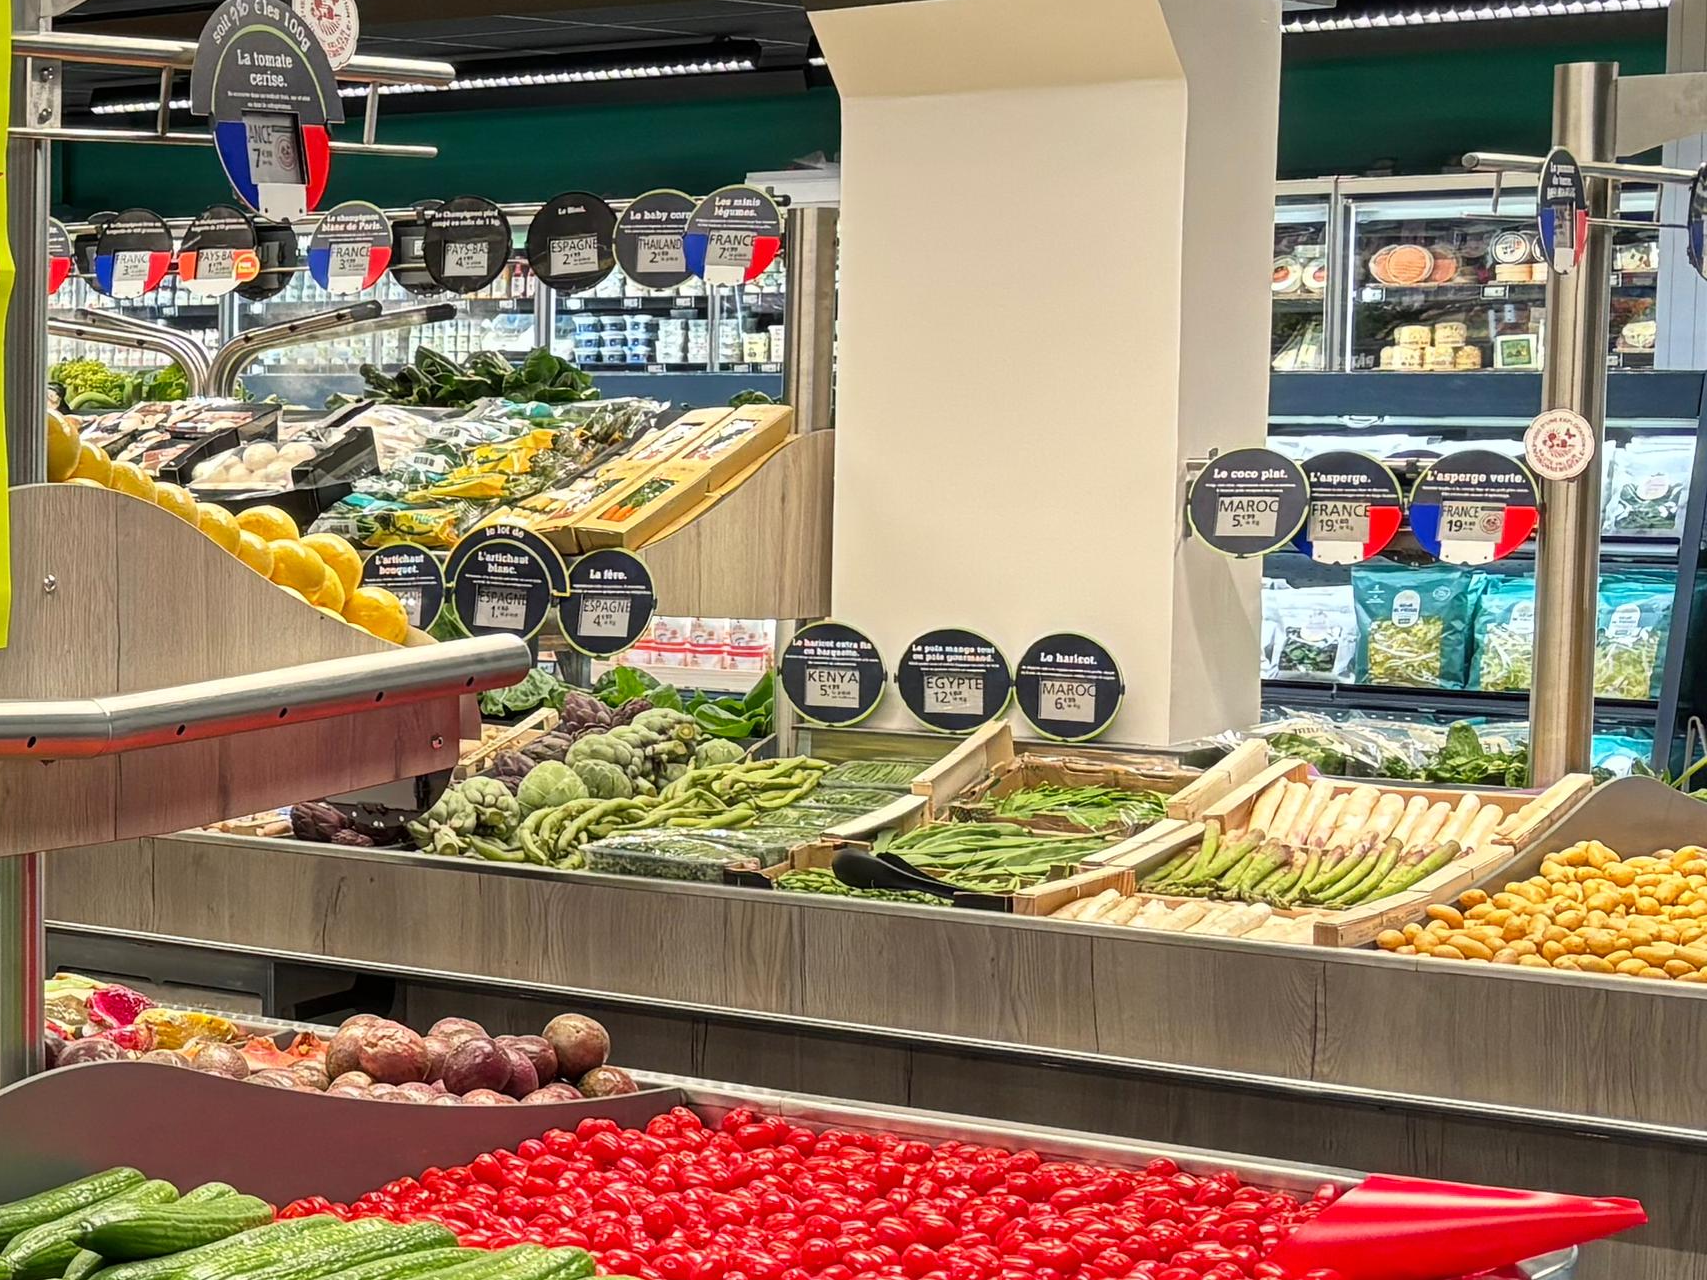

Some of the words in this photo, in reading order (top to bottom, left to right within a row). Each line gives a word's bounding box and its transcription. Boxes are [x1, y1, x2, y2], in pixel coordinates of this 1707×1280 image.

[262, 0, 280, 20] les
[284, 12, 311, 53] 100g
[237, 49, 251, 66] La
[254, 51, 293, 69] tomate
[250, 71, 288, 87] cerise.
[248, 124, 273, 145] ANCE
[715, 197, 730, 206] Les
[734, 197, 761, 206] minis
[630, 211, 641, 220] Le
[643, 210, 667, 223] baby
[714, 206, 757, 217] légumes.
[327, 214, 336, 222] Le
[337, 213, 379, 224] champignon
[322, 222, 344, 232] blanc
[346, 222, 356, 231] de
[359, 220, 383, 231] Paris.
[551, 239, 597, 253] ESPAGNE
[638, 238, 682, 251] THAILAND
[115, 253, 147, 265] FRANC
[198, 250, 233, 262] PAYS-BA
[1214, 468, 1227, 480] Le
[1231, 469, 1256, 480] coco
[1261, 468, 1288, 481] plat.
[1310, 472, 1371, 486] L'asperge.
[1426, 470, 1486, 485] L'asperge
[1490, 472, 1526, 484] verte.
[1219, 499, 1277, 513] MAROC
[1312, 503, 1370, 517] FRANCE
[1442, 504, 1479, 518] FRANCE
[497, 524, 511, 535] lot
[375, 553, 424, 565] L'artichaut
[478, 551, 529, 565] L'artichaut
[487, 564, 518, 575] blanc.
[590, 568, 601, 580] La
[480, 590, 526, 606] ESPAGNE
[584, 599, 631, 613] ESPAGNE
[793, 638, 802, 646] Le
[804, 638, 834, 648] haricot
[912, 644, 922, 652] Le
[945, 645, 975, 656] mange
[1040, 652, 1053, 664] Le
[1056, 652, 1097, 665] haricot.
[808, 670, 859, 684] KENYA
[926, 676, 983, 690] EGYPTE
[1043, 683, 1096, 698] MAROC
